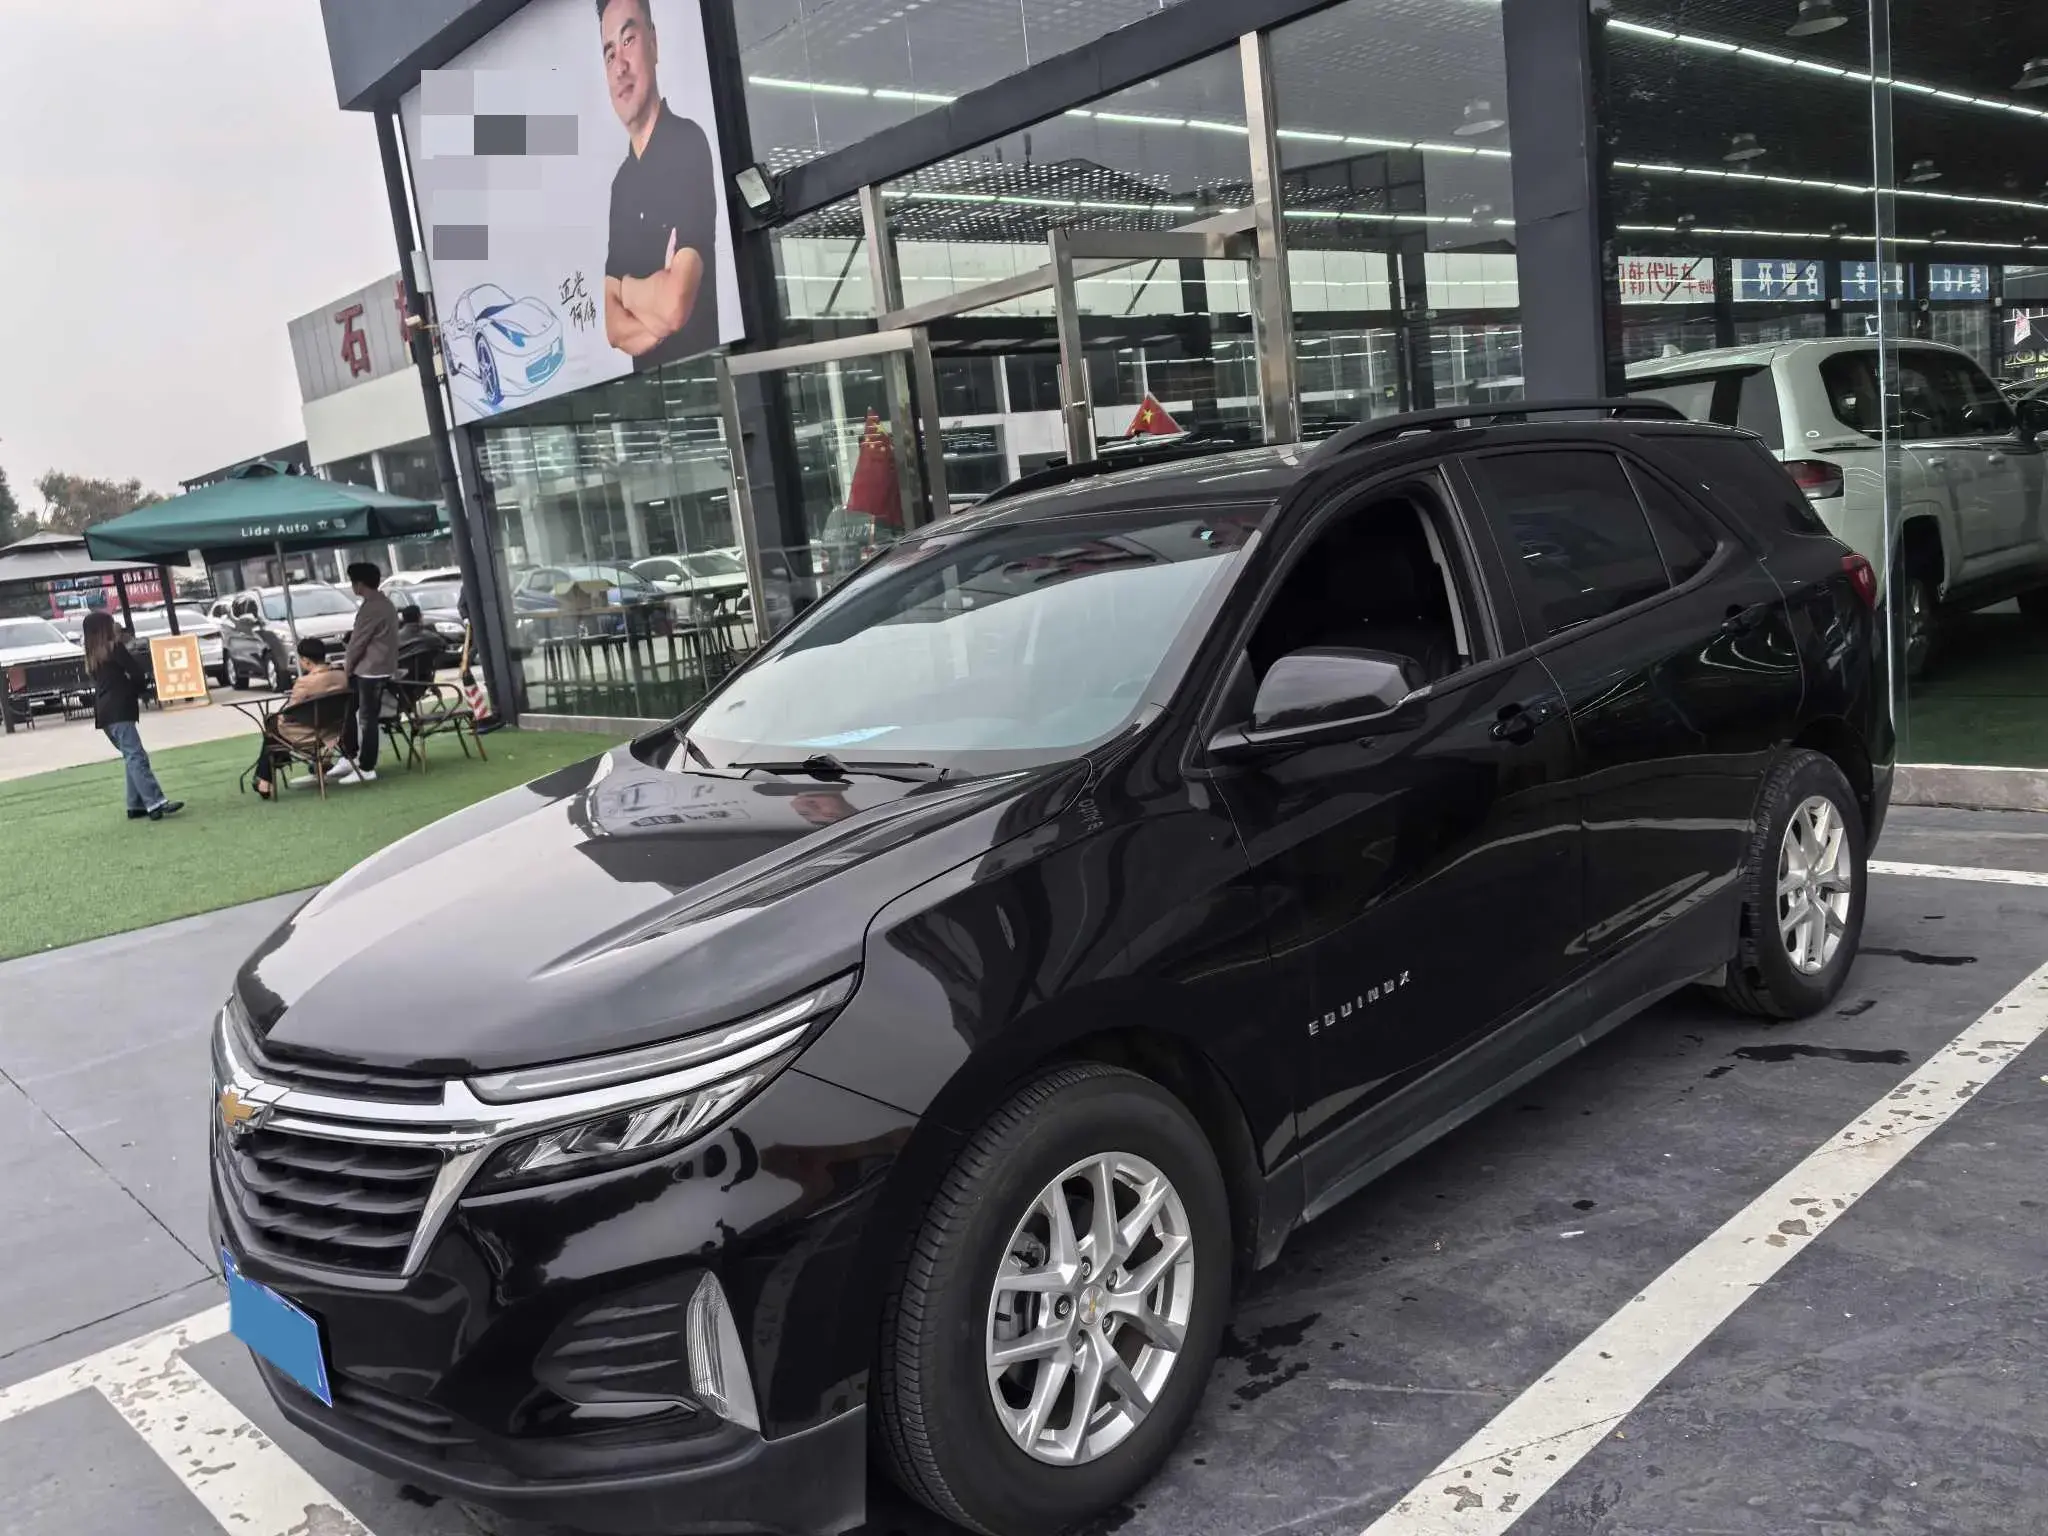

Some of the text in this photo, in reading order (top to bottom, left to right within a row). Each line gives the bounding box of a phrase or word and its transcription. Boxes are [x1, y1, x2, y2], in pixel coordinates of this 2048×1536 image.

[241, 525, 271, 537] Lide
[278, 522, 310, 535] Auto
[1308, 970, 1410, 1036] EQUINOX
